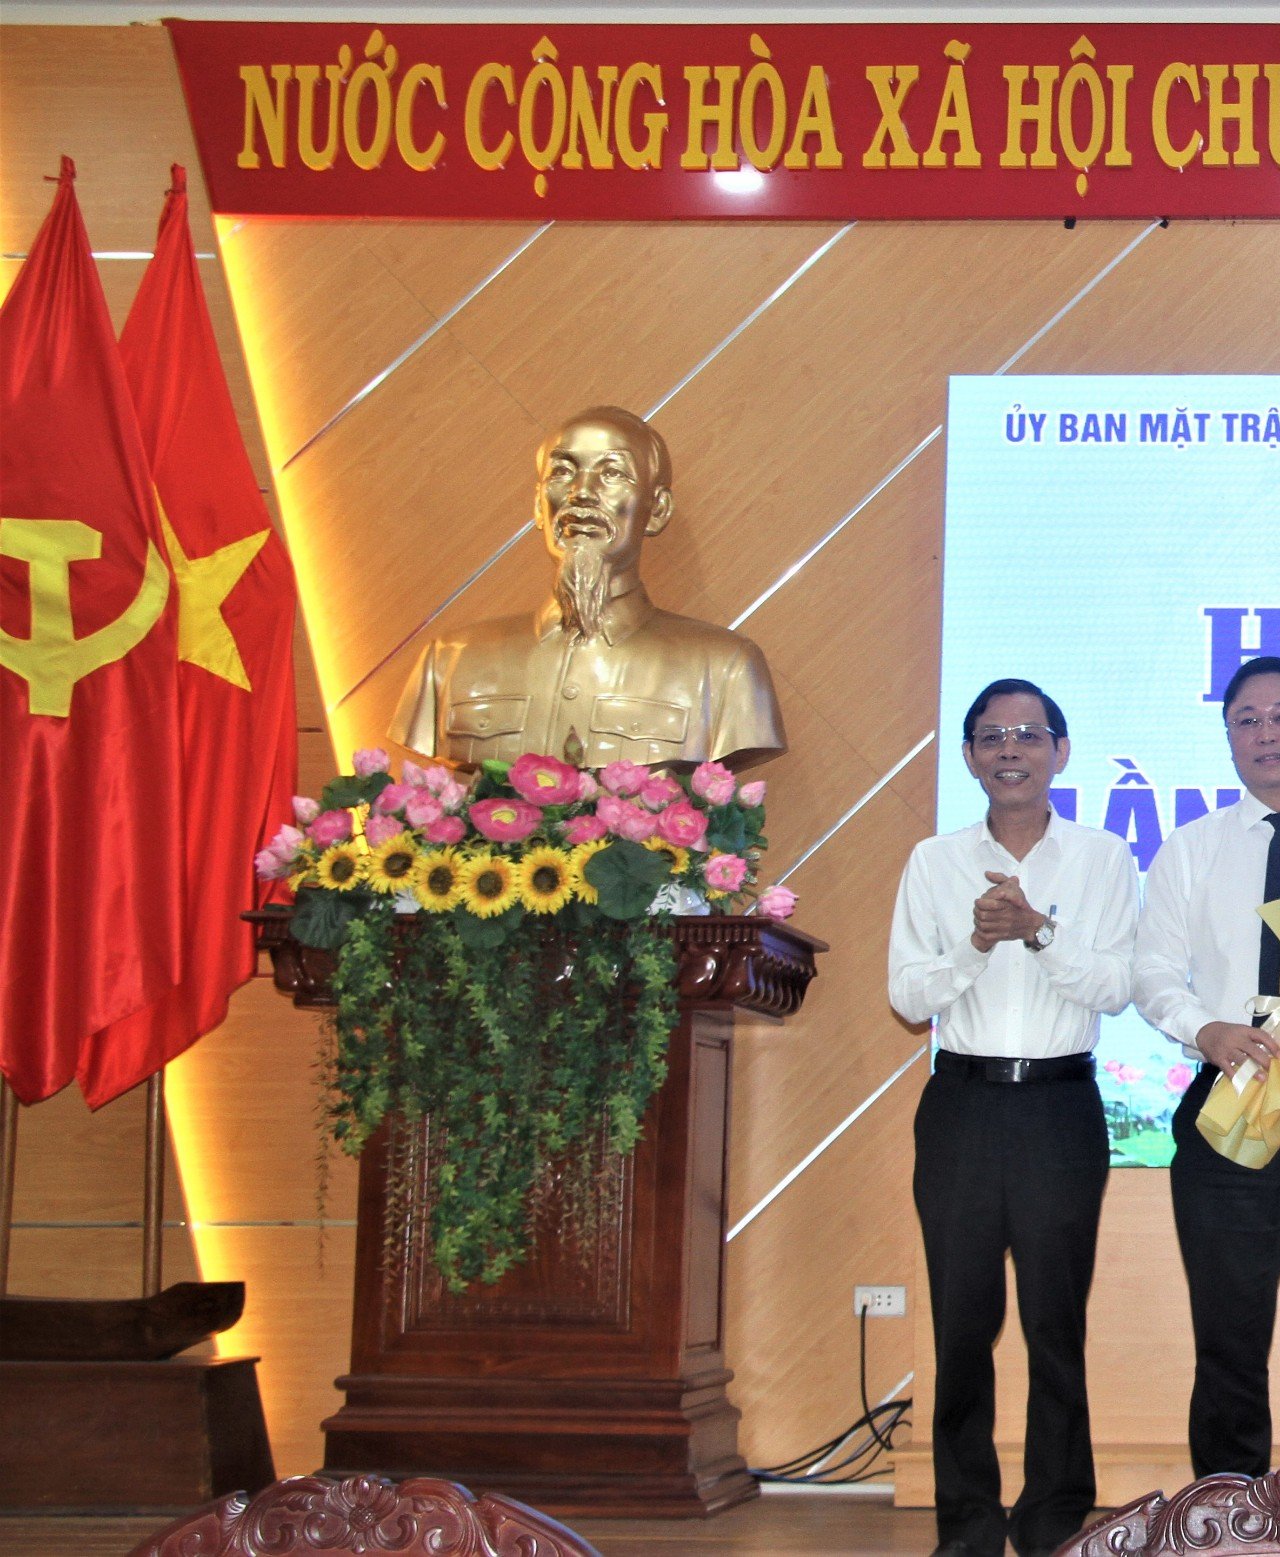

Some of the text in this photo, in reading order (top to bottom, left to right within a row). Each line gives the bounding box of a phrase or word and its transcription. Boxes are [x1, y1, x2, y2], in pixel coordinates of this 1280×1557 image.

[238, 29, 446, 171] NƯỚC
[465, 36, 671, 197] CỘNG
[681, 33, 843, 170] HÒA
[862, 39, 982, 167] XÃ
[999, 36, 1134, 196] HỘI
[1005, 403, 1047, 443] ỦY
[1059, 413, 1127, 443] BAN
[1139, 407, 1211, 449] MẶT
